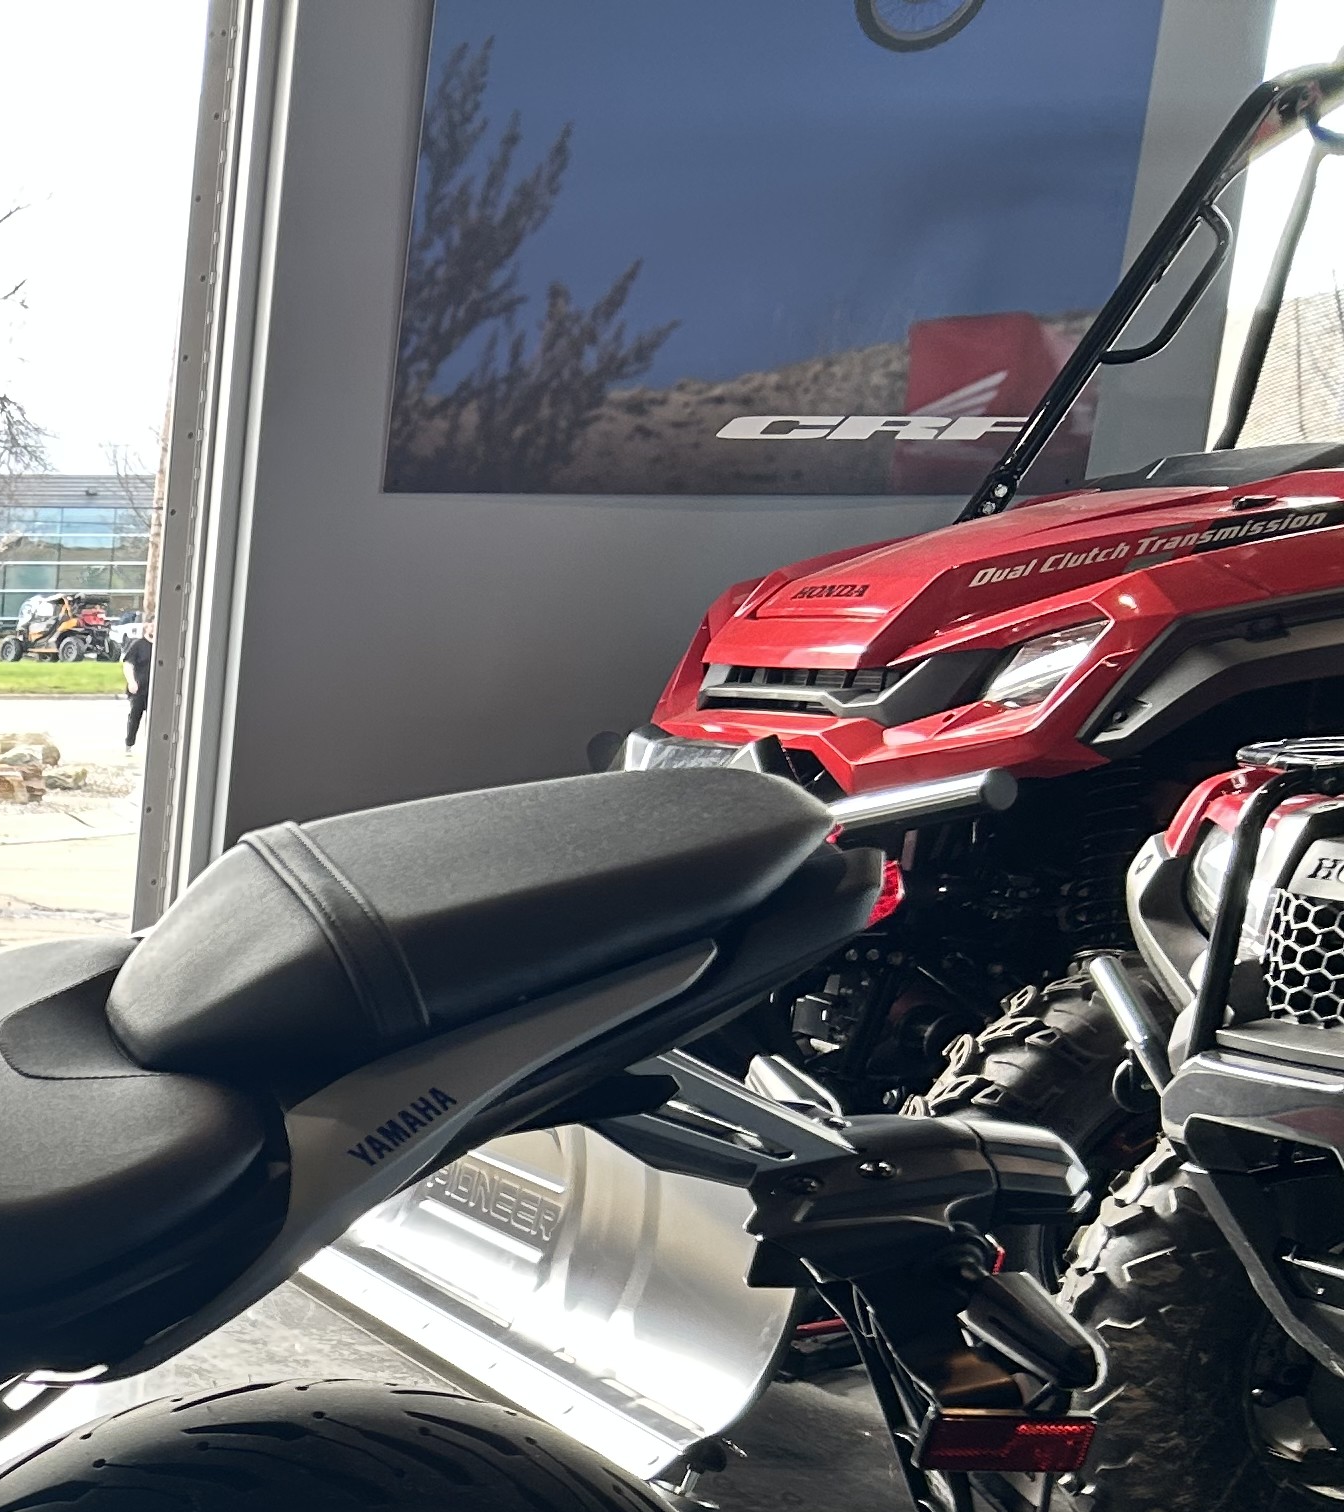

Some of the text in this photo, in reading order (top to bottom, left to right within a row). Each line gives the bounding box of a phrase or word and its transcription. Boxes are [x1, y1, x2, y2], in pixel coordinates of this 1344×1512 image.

[715, 415, 1030, 441] CRF
[967, 512, 1328, 588] Dual Clutch Transmission
[790, 583, 871, 601] HONDA
[346, 1086, 458, 1168] YAMAHA
